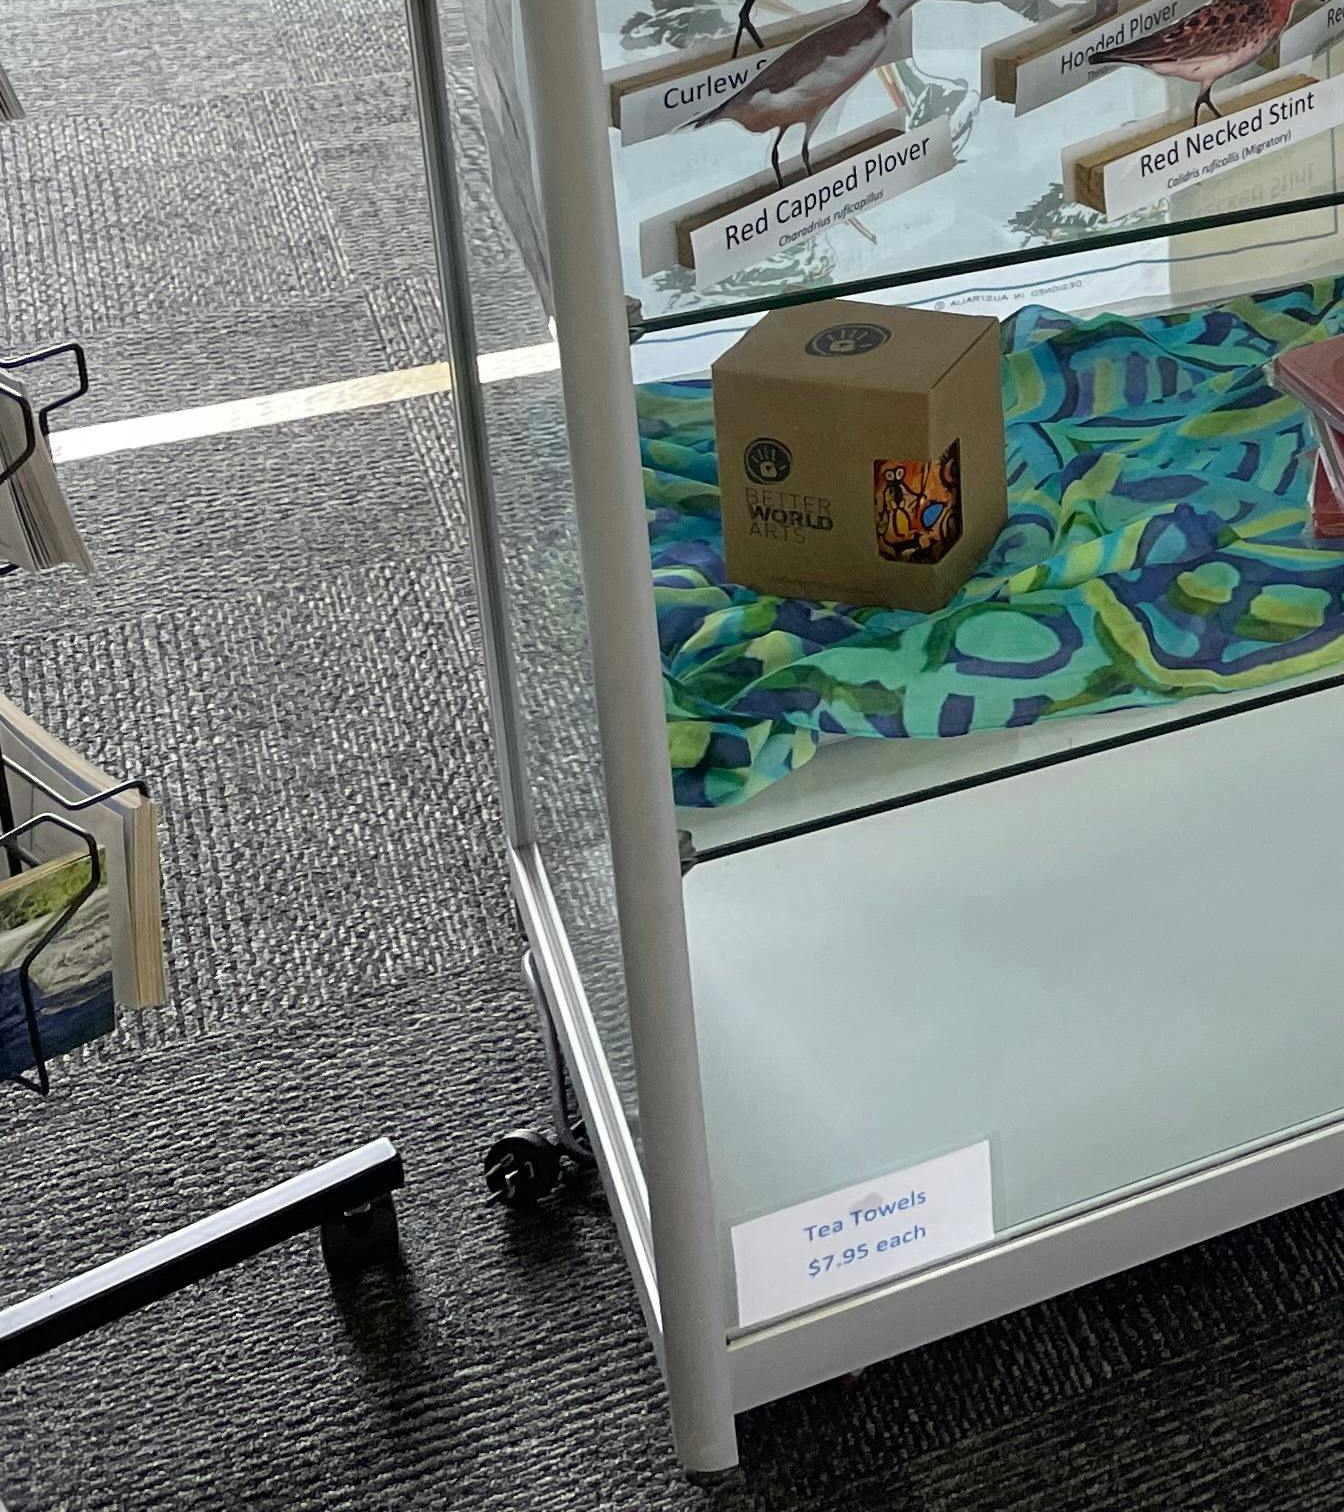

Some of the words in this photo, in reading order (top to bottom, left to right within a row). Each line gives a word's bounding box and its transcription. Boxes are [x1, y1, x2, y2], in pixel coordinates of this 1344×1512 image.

[662, 71, 750, 111] Curlew
[1140, 143, 1182, 178] Red
[1185, 108, 1264, 156] Necked
[1268, 90, 1315, 126] Stint
[1241, 129, 1293, 163] (Migratory)
[723, 204, 769, 251] Red
[774, 171, 860, 226] Capped
[863, 136, 932, 187] Plover
[745, 488, 833, 515] BETTER
[747, 505, 835, 532] WORLD
[748, 524, 807, 545] ARTS
[804, 1219, 843, 1242] Tea
[850, 1189, 927, 1227] Towels
[808, 1242, 870, 1278] $7.95
[876, 1224, 927, 1254] each
